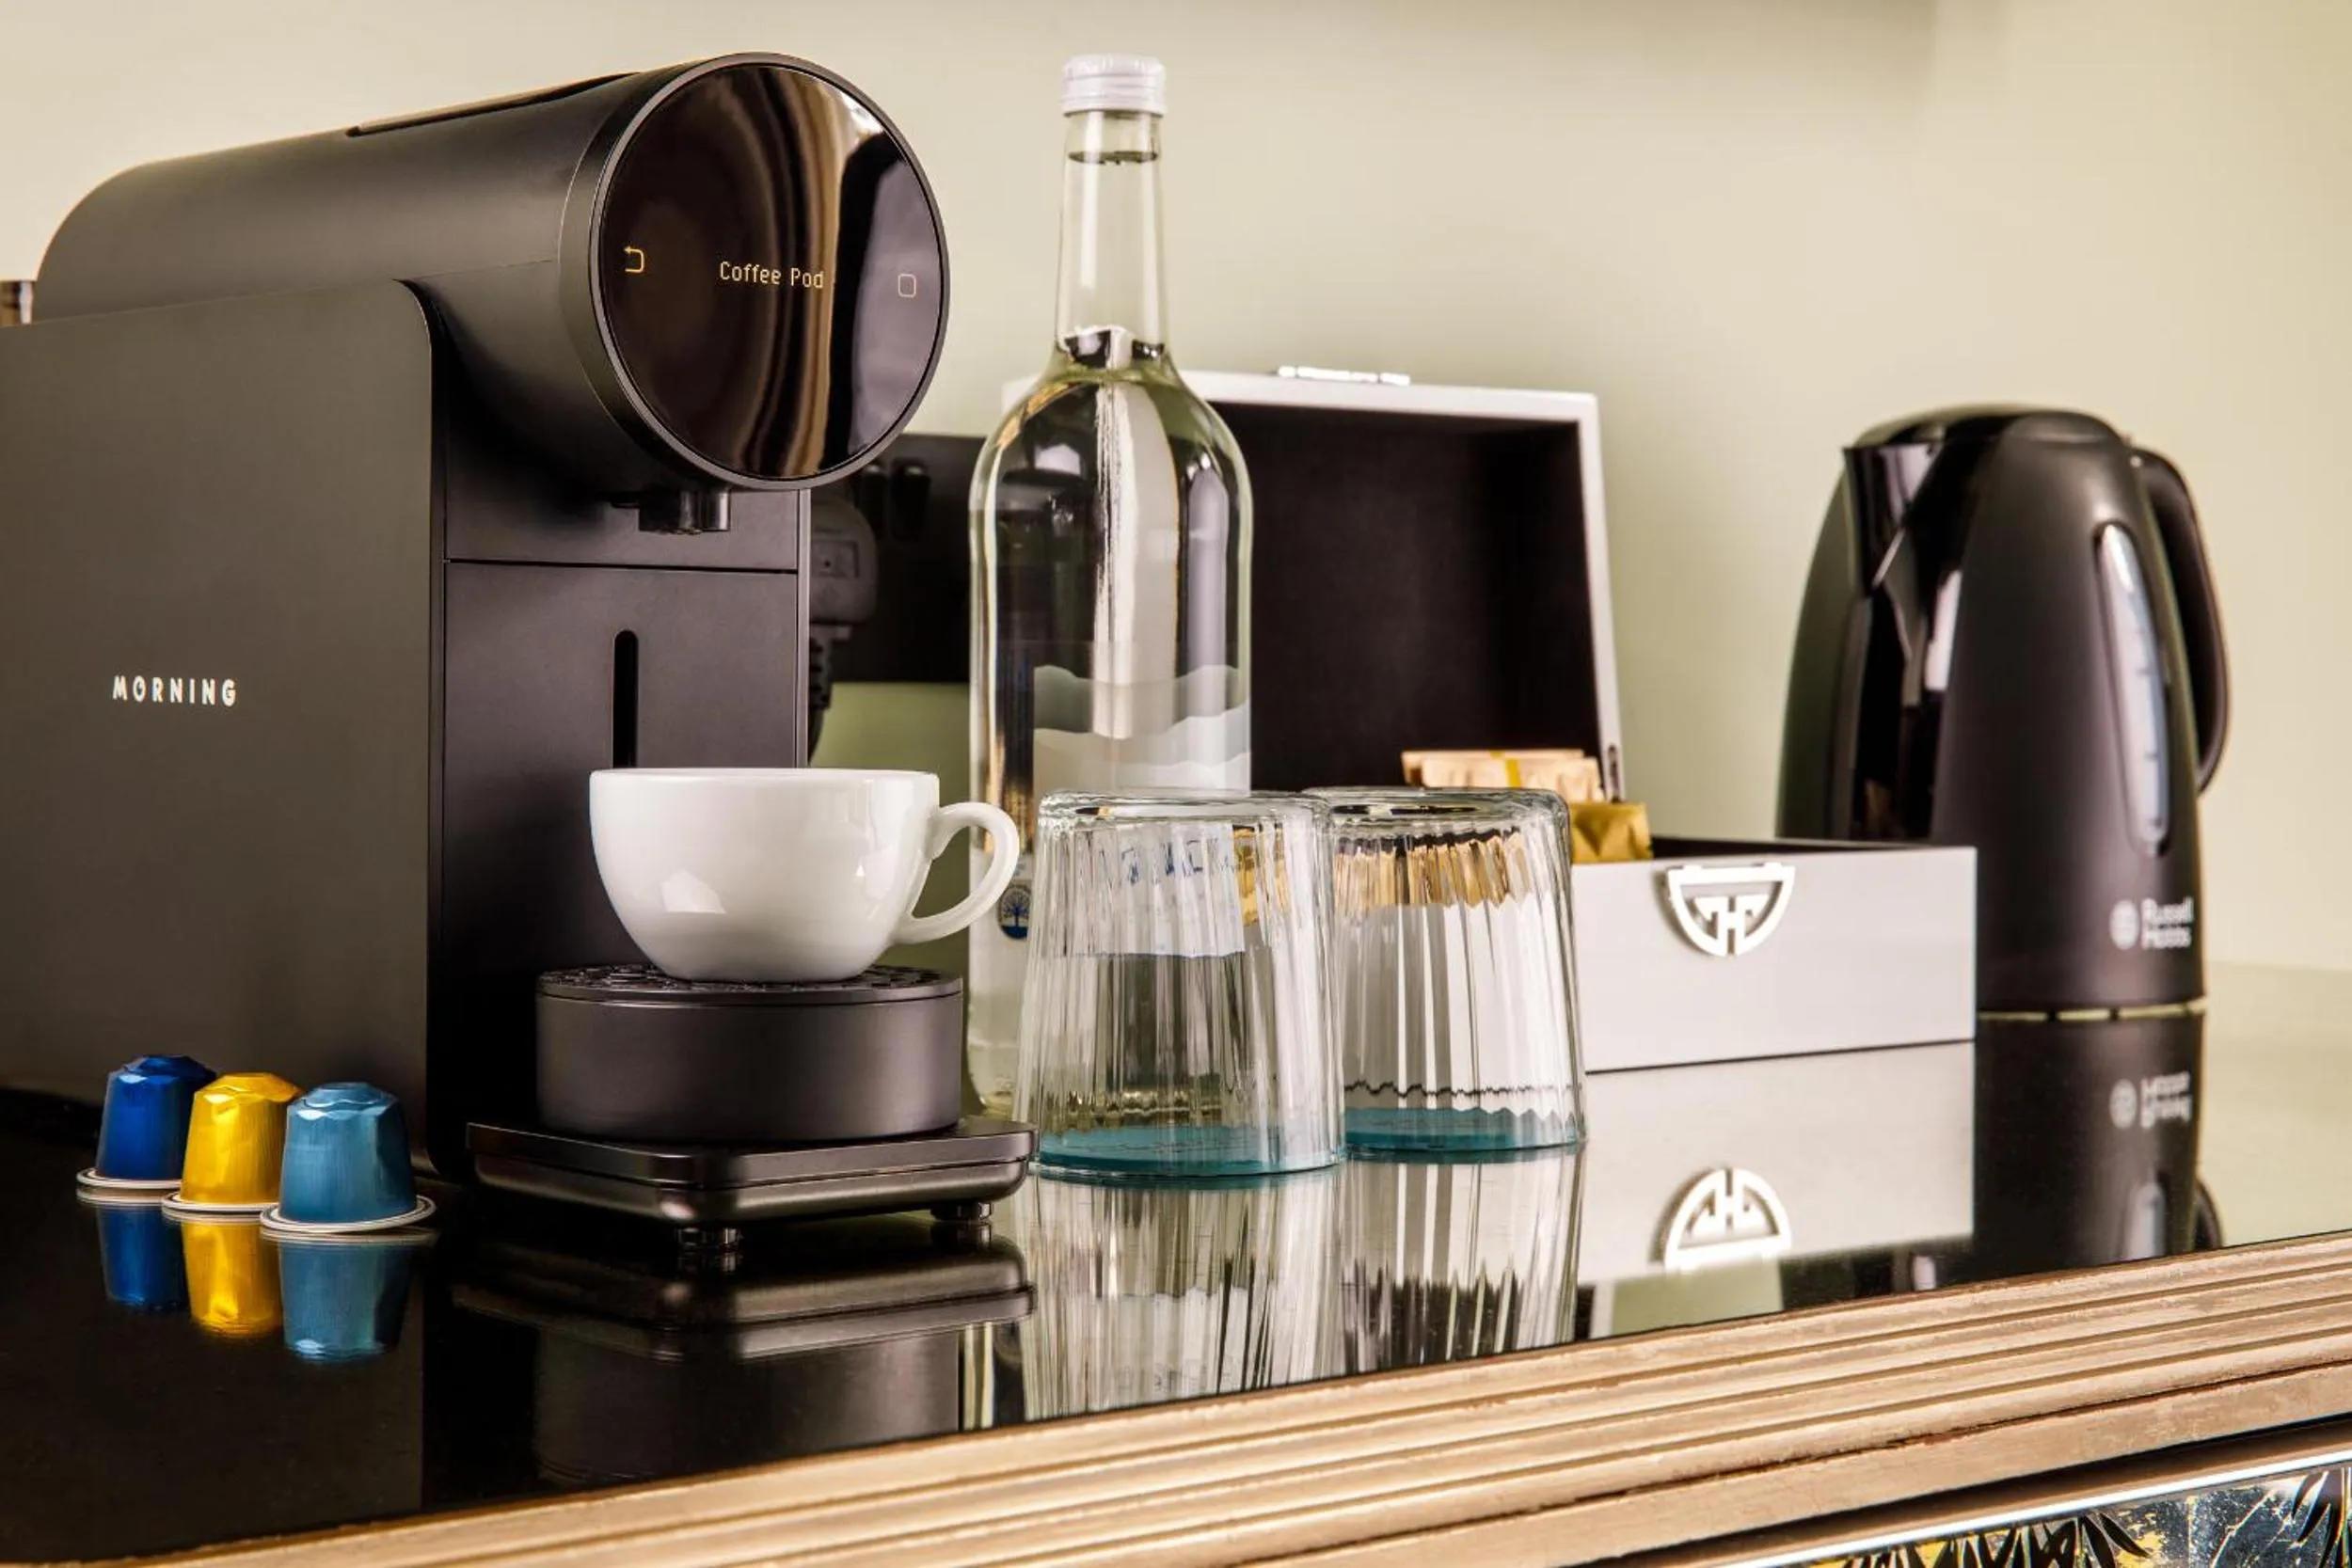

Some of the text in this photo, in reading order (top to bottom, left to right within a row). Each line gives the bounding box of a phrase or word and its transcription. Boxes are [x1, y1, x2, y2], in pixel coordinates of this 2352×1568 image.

[720, 261, 825, 289] Coffee Pod
[112, 674, 236, 707] MORNING
